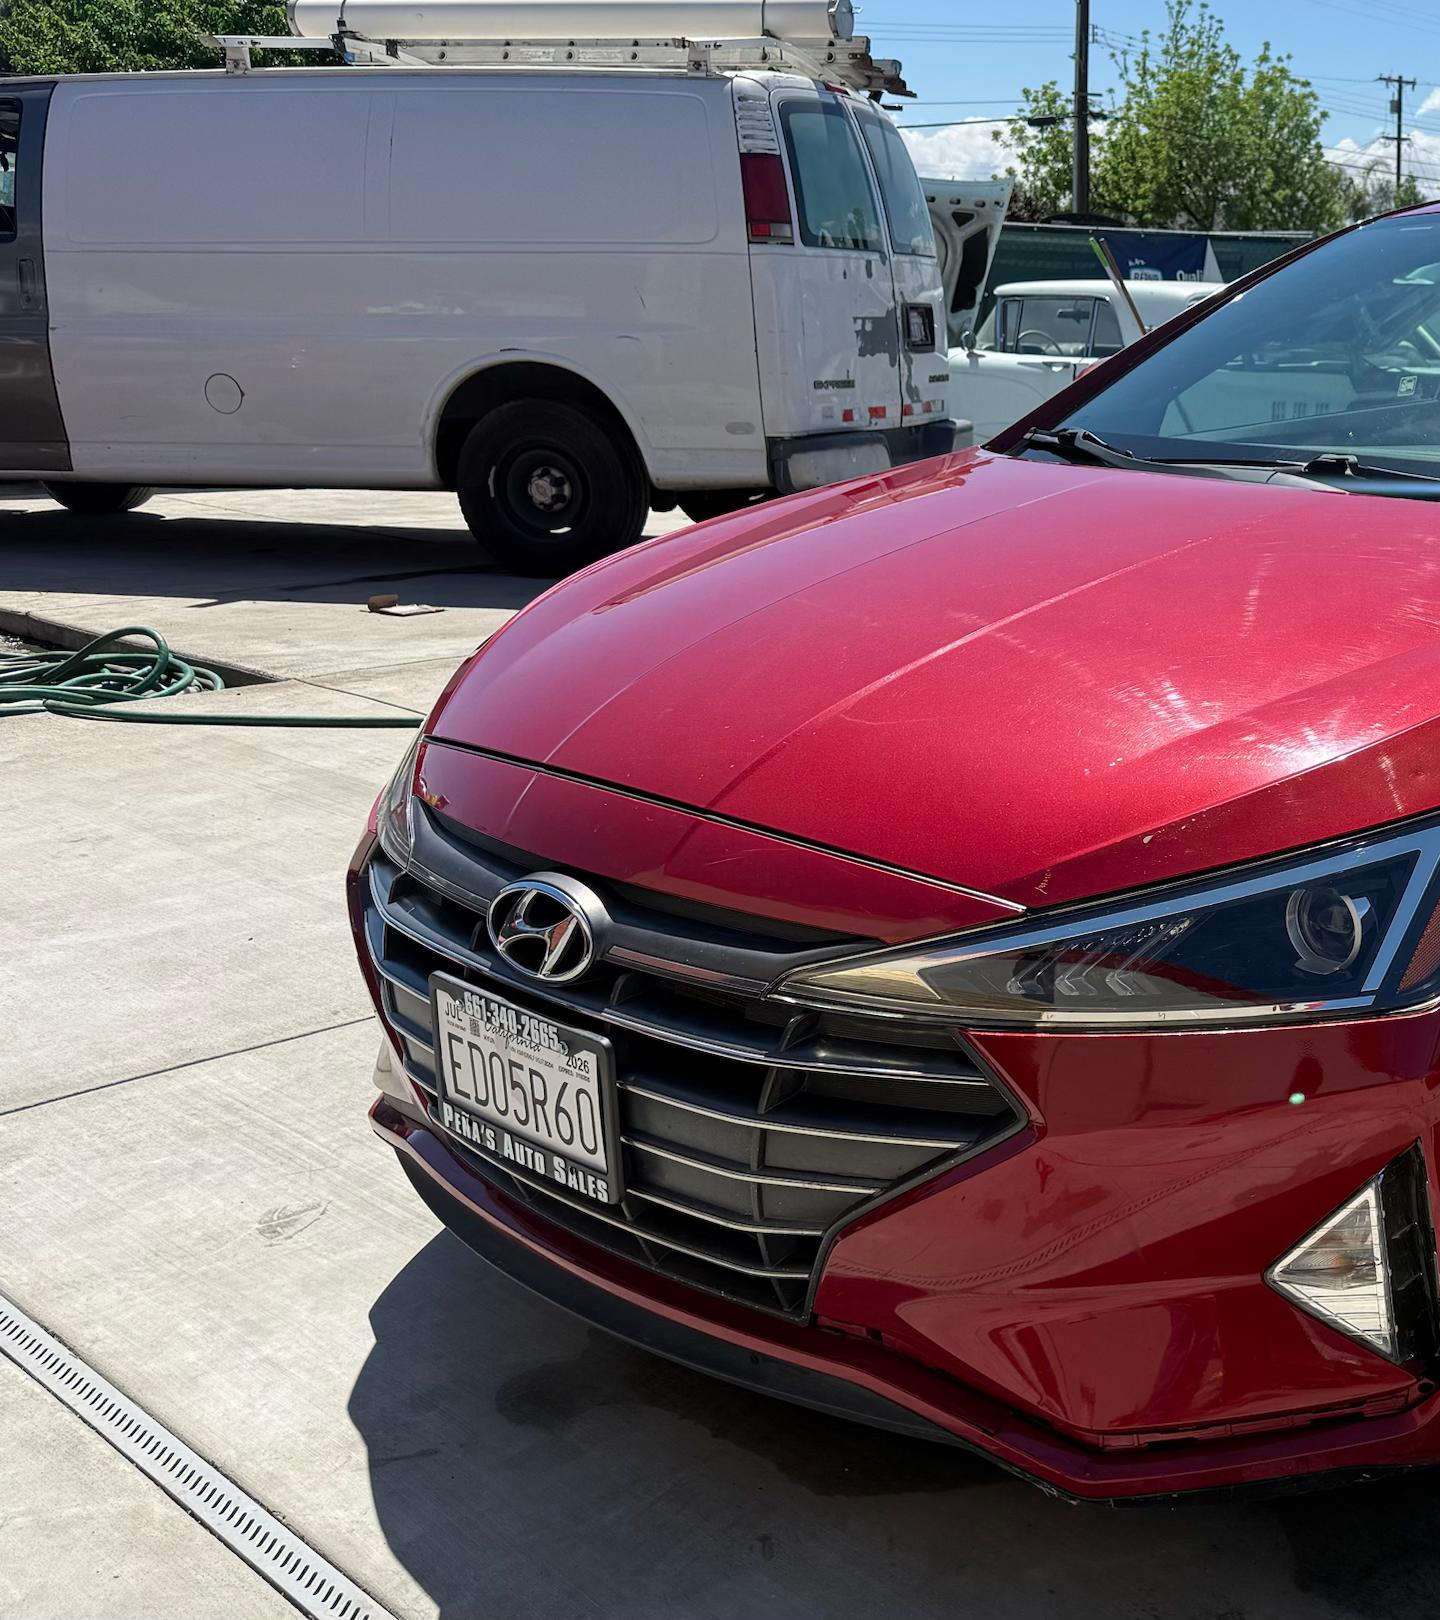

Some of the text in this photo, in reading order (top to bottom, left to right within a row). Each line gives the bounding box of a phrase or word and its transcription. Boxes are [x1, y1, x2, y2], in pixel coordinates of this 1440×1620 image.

[463, 991, 560, 1053] 661-340-2665
[447, 1031, 598, 1155] ED05R60
[565, 1055, 590, 1074] 2026
